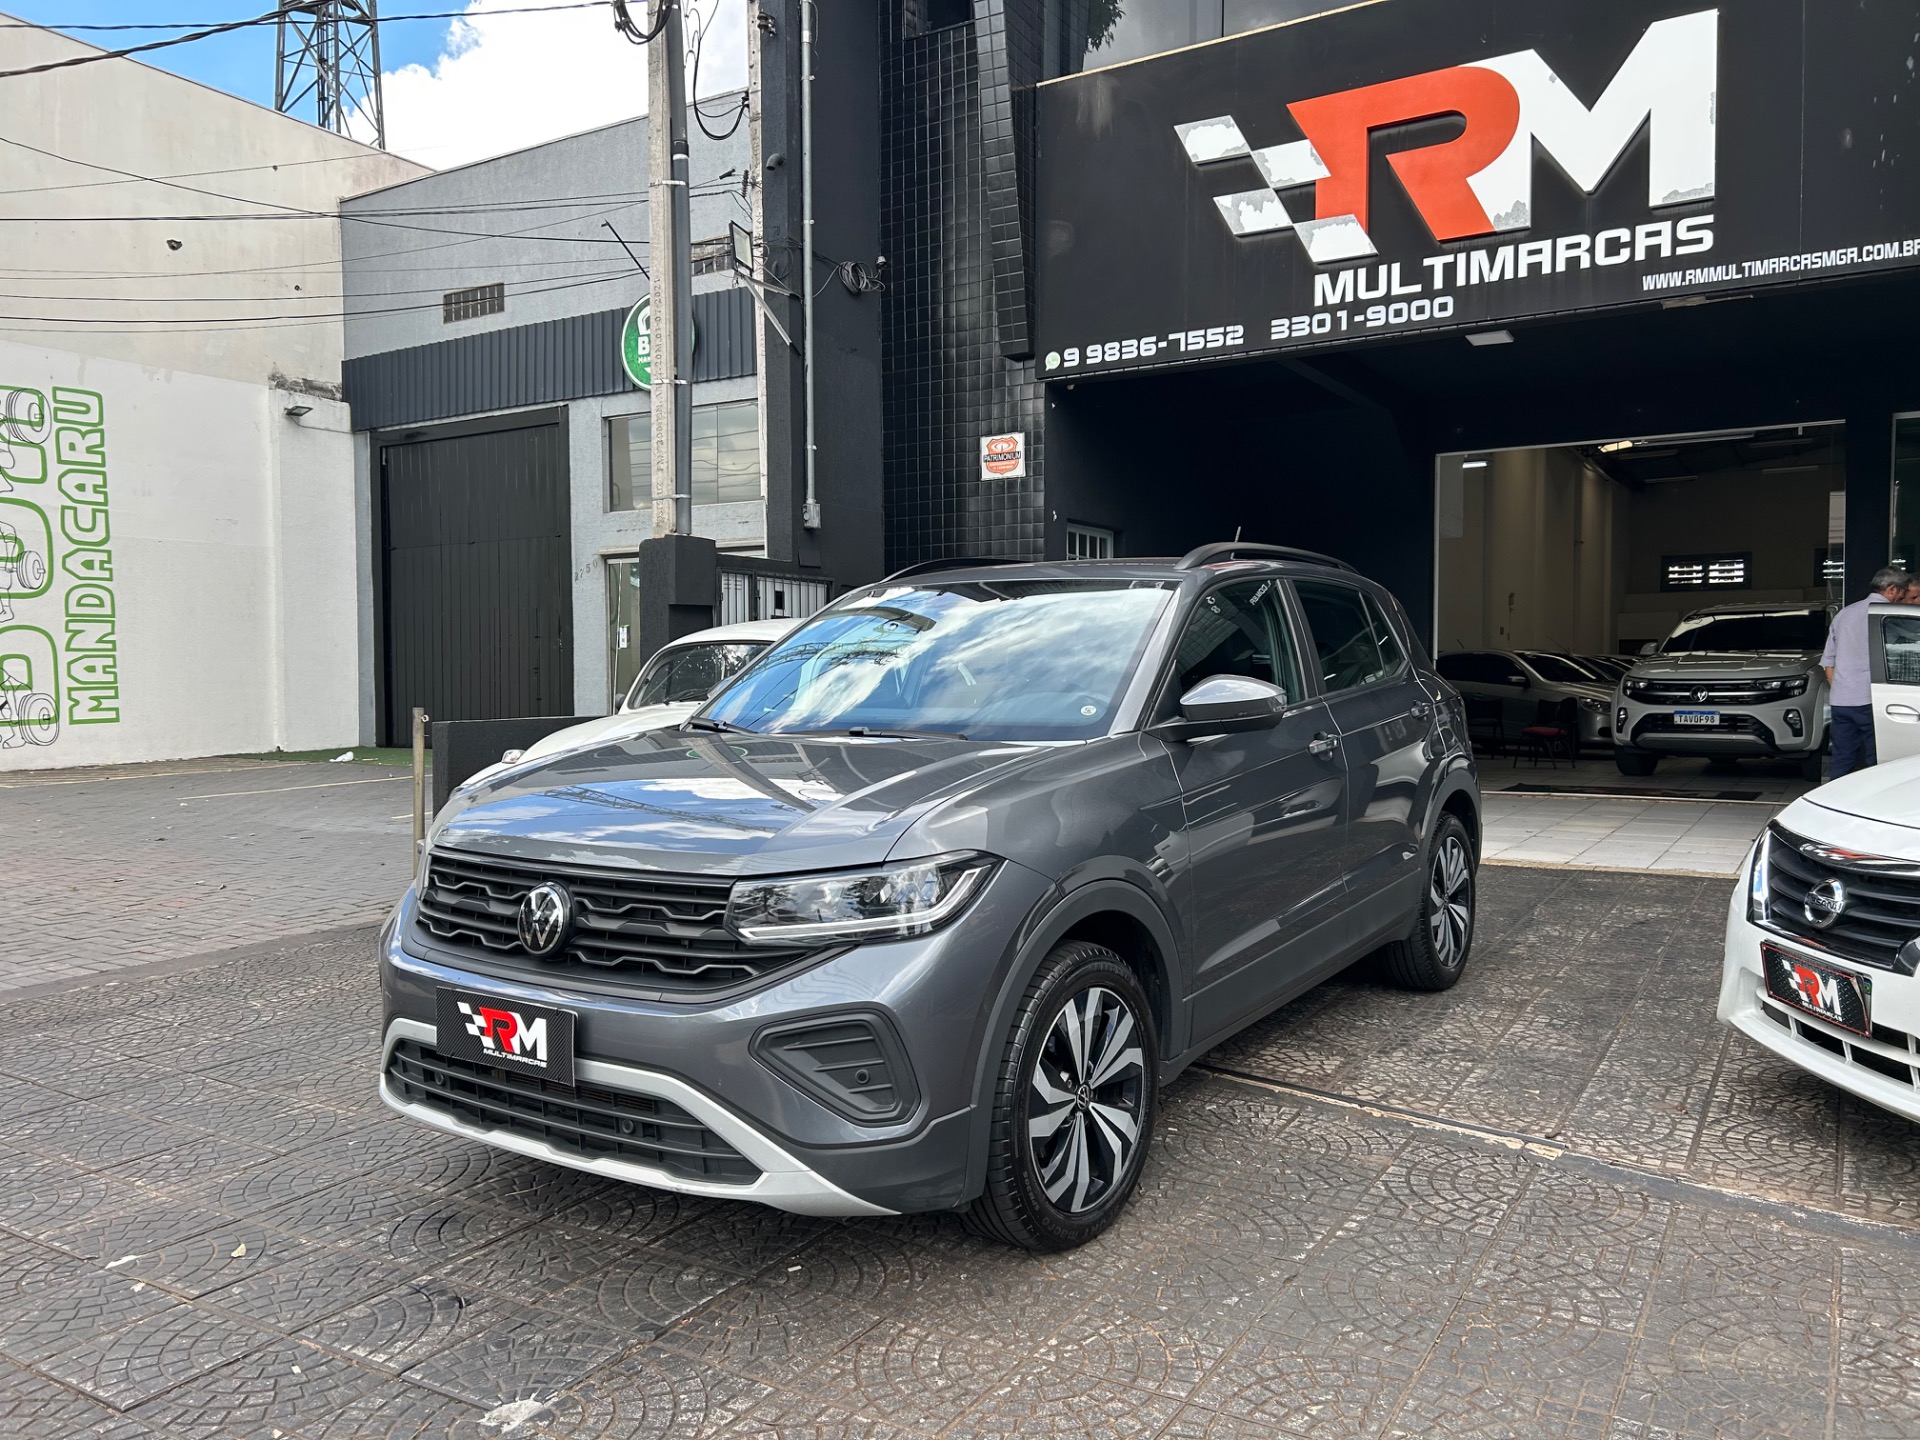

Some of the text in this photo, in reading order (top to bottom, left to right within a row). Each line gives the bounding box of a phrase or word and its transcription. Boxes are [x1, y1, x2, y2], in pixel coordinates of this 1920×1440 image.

[1287, 8, 1718, 241] RM
[1314, 214, 1715, 306] MULTIMARCAS
[1063, 295, 1454, 368] 9 9836-7552 3301-9000
[984, 451, 1021, 462] PATRIMONIUM
[52, 386, 120, 725] MANDACARU
[574, 558, 598, 582] 2750
[1793, 964, 1841, 1015] RM
[479, 1006, 547, 1061] RM
[483, 1047, 548, 1069] MULTIMARCAS
